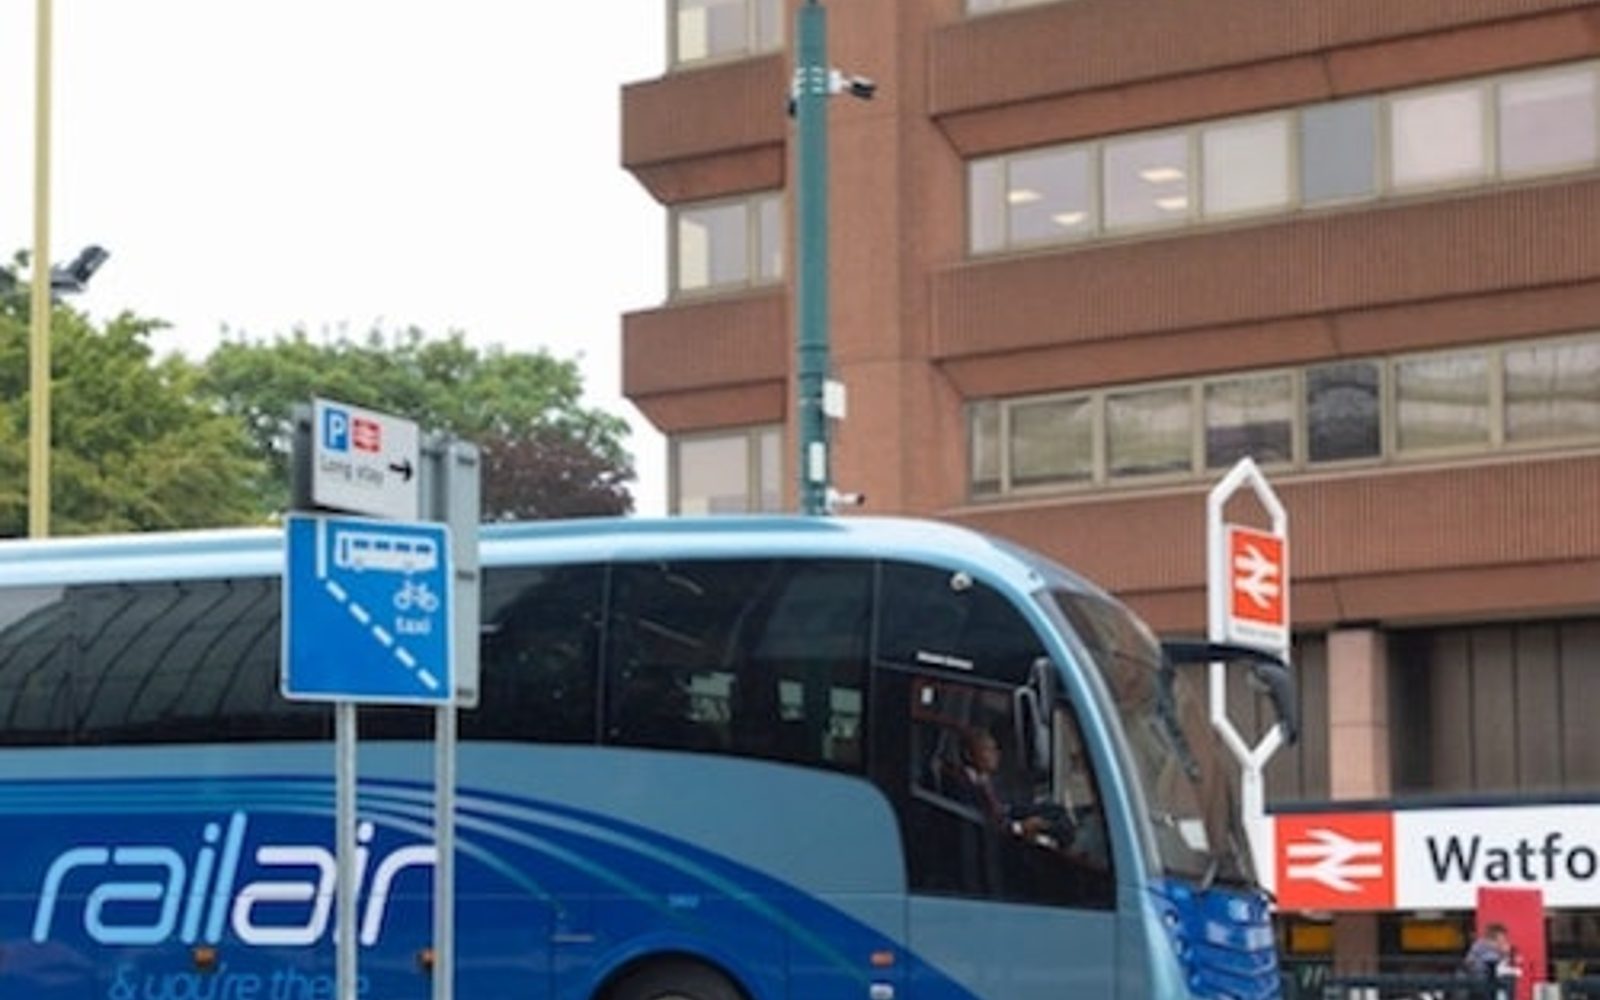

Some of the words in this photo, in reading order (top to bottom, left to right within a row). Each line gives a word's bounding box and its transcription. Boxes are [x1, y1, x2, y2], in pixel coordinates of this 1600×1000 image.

[329, 412, 346, 447] P
[396, 616, 432, 635] taxi
[1426, 832, 1597, 882] Watfo
[31, 811, 438, 946] railair
[107, 963, 136, 1000] &
[270, 966, 370, 1000] thee
